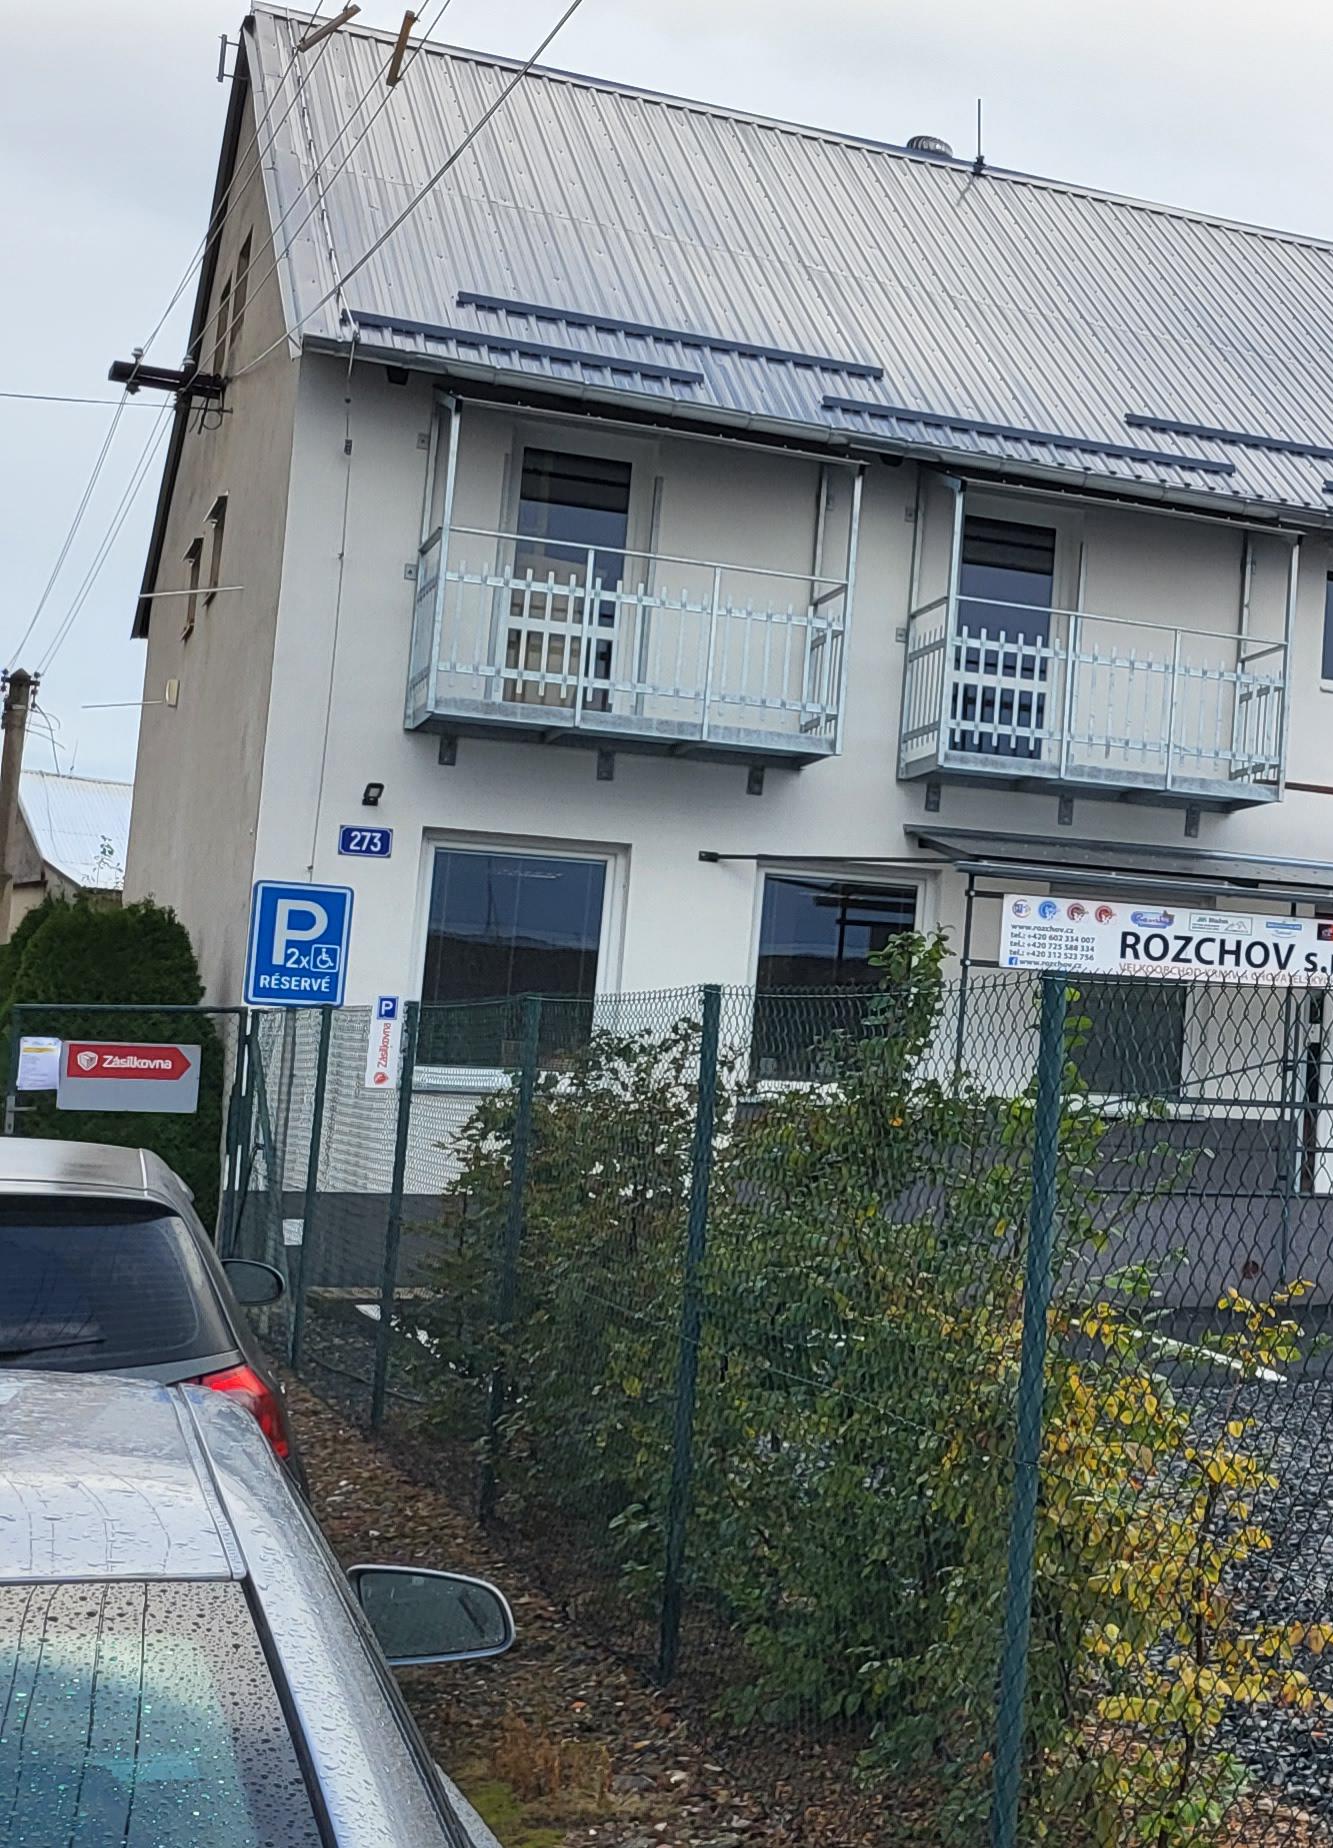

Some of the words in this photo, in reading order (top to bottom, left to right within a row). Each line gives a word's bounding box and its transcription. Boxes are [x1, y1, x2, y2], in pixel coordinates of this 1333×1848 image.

[350, 831, 382, 851] 273
[272, 898, 329, 965] P
[1081, 936, 1096, 944] 007
[286, 947, 310, 969] 2x
[1119, 931, 1296, 971] ROZCHOV
[260, 973, 331, 992] RÉSERVÉ
[381, 1000, 394, 1015] P
[102, 1054, 172, 1070] Zásilkovna
